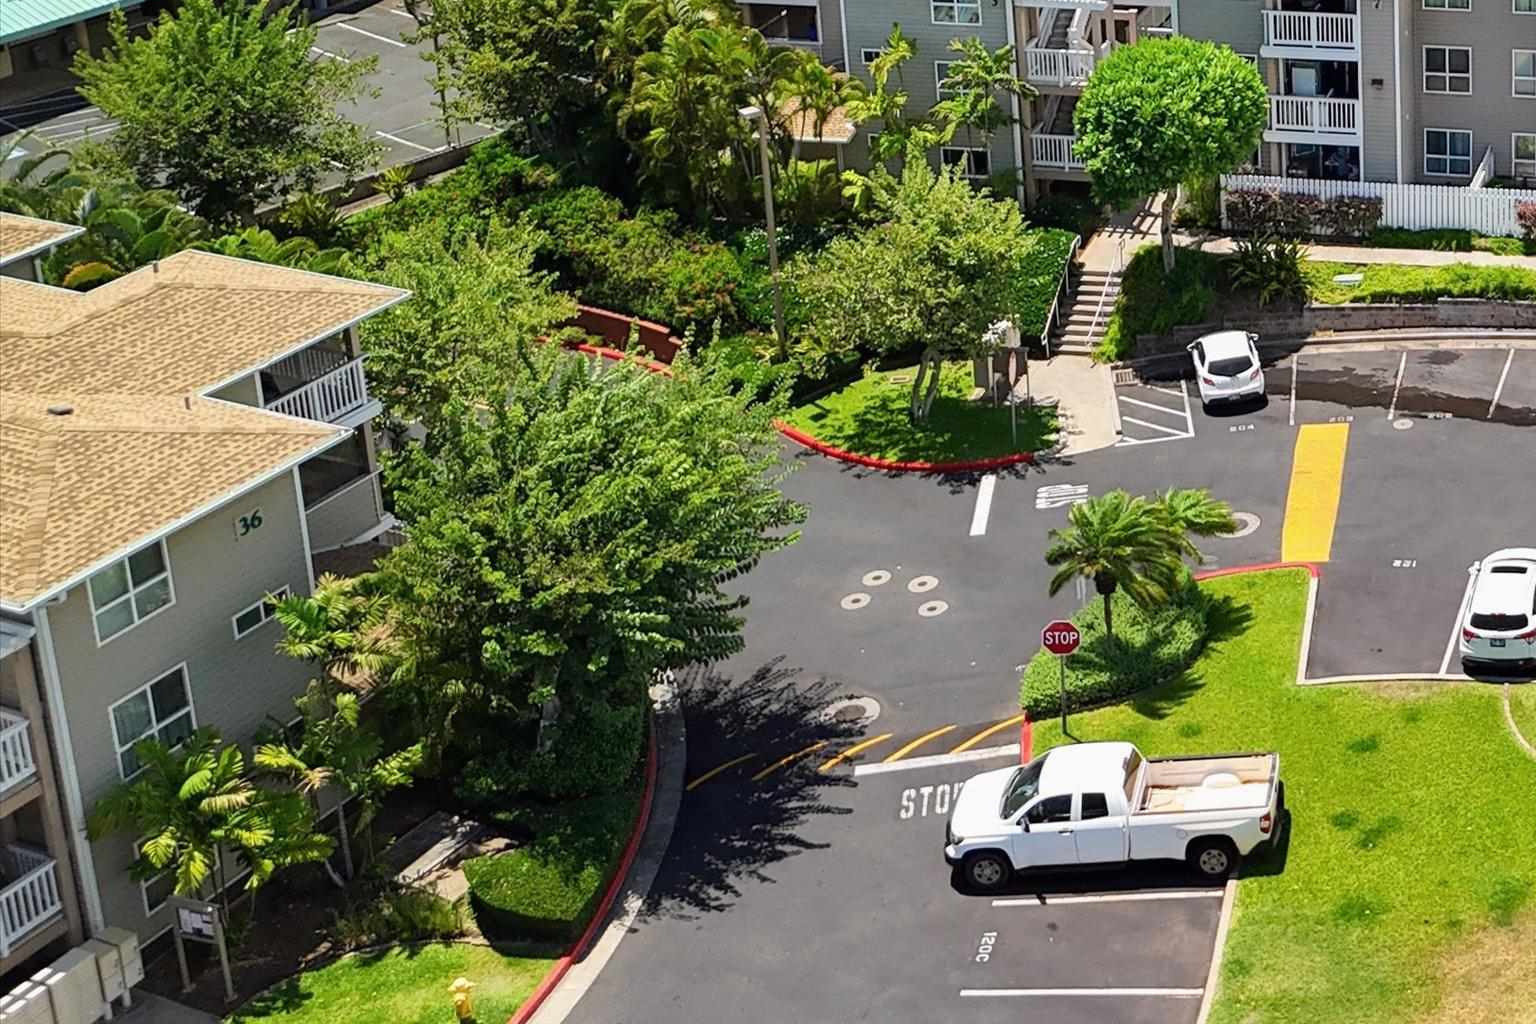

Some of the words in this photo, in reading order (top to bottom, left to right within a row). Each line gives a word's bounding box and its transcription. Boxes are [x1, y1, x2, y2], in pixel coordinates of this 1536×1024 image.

[239, 508, 263, 537] 36
[1044, 631, 1079, 645] STOP
[975, 931, 998, 963] 120C
